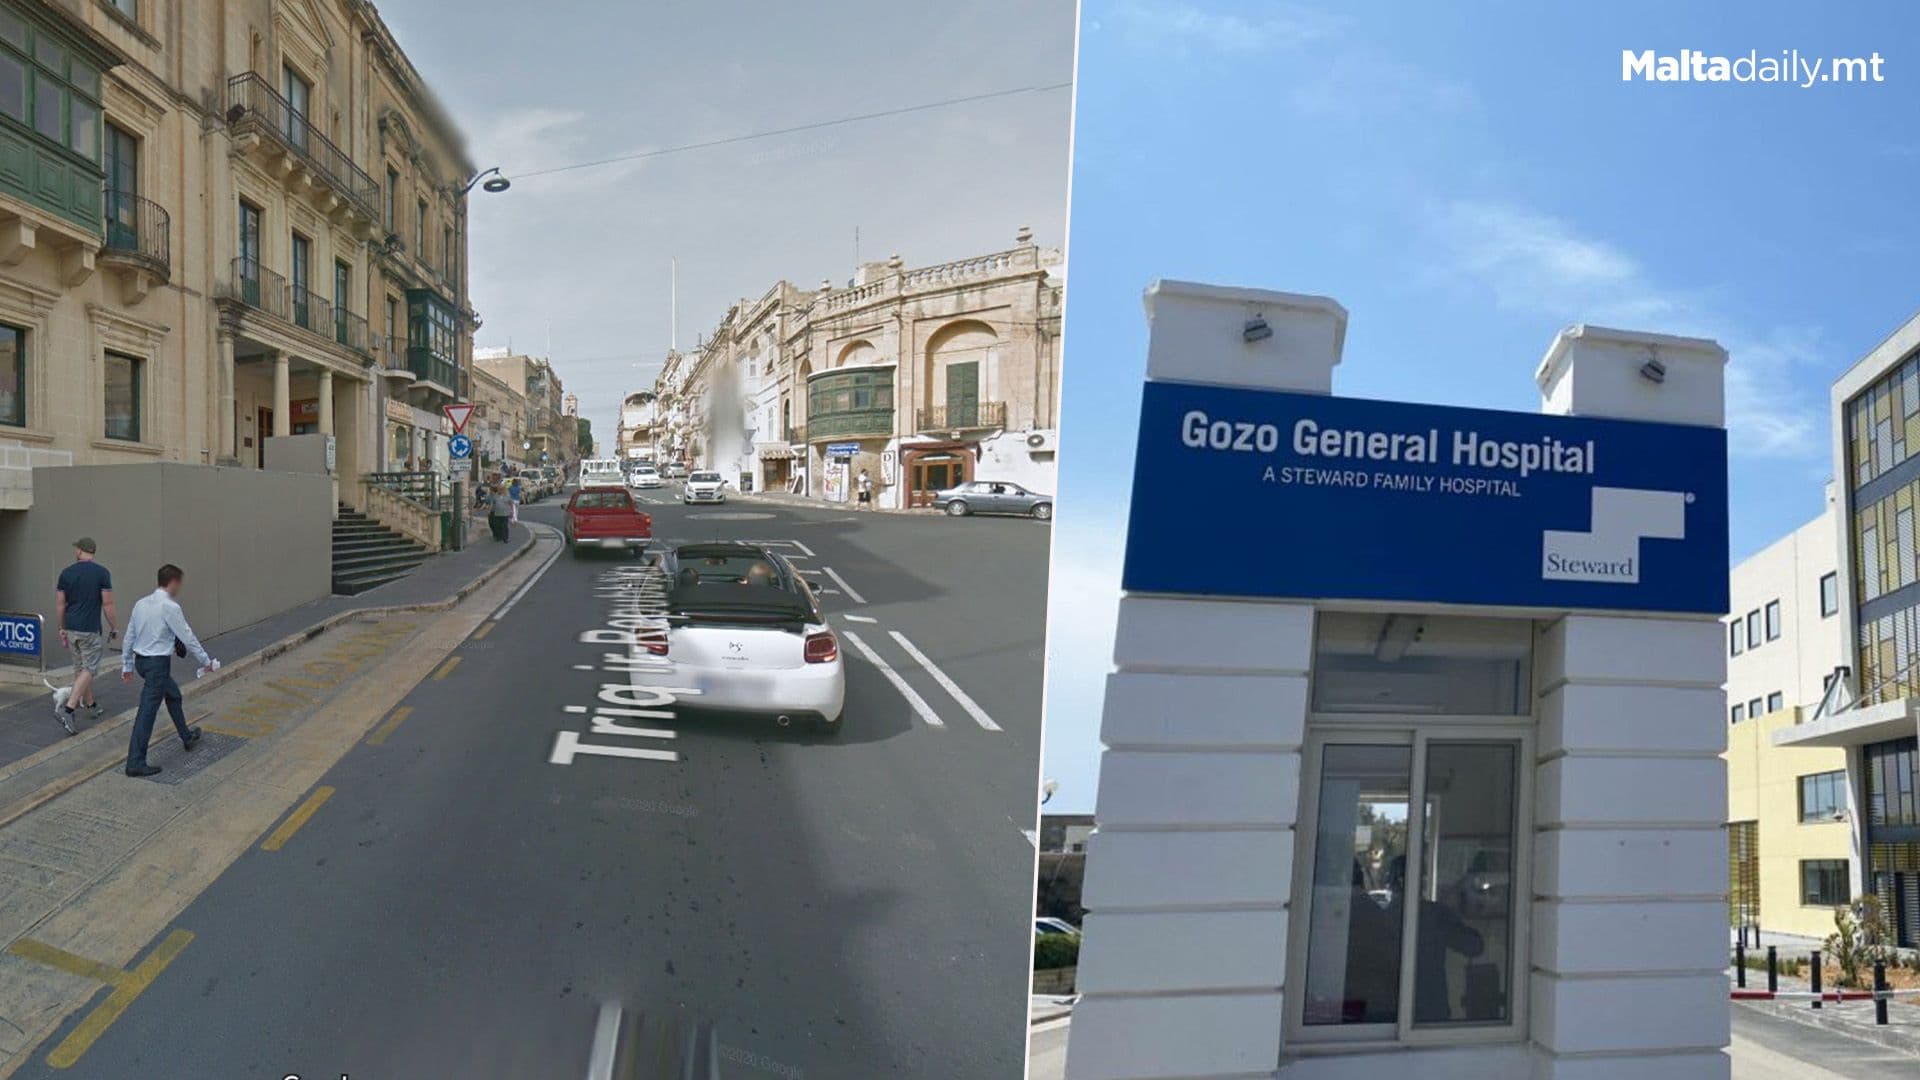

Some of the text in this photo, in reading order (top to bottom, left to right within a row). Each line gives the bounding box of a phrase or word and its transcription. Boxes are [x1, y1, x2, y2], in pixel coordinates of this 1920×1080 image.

[1181, 410, 1595, 478] Gozo General Hospital
[1263, 466, 1522, 497] A STEWARD FAMILY HOSPITAL
[1547, 553, 1633, 576] Steward
